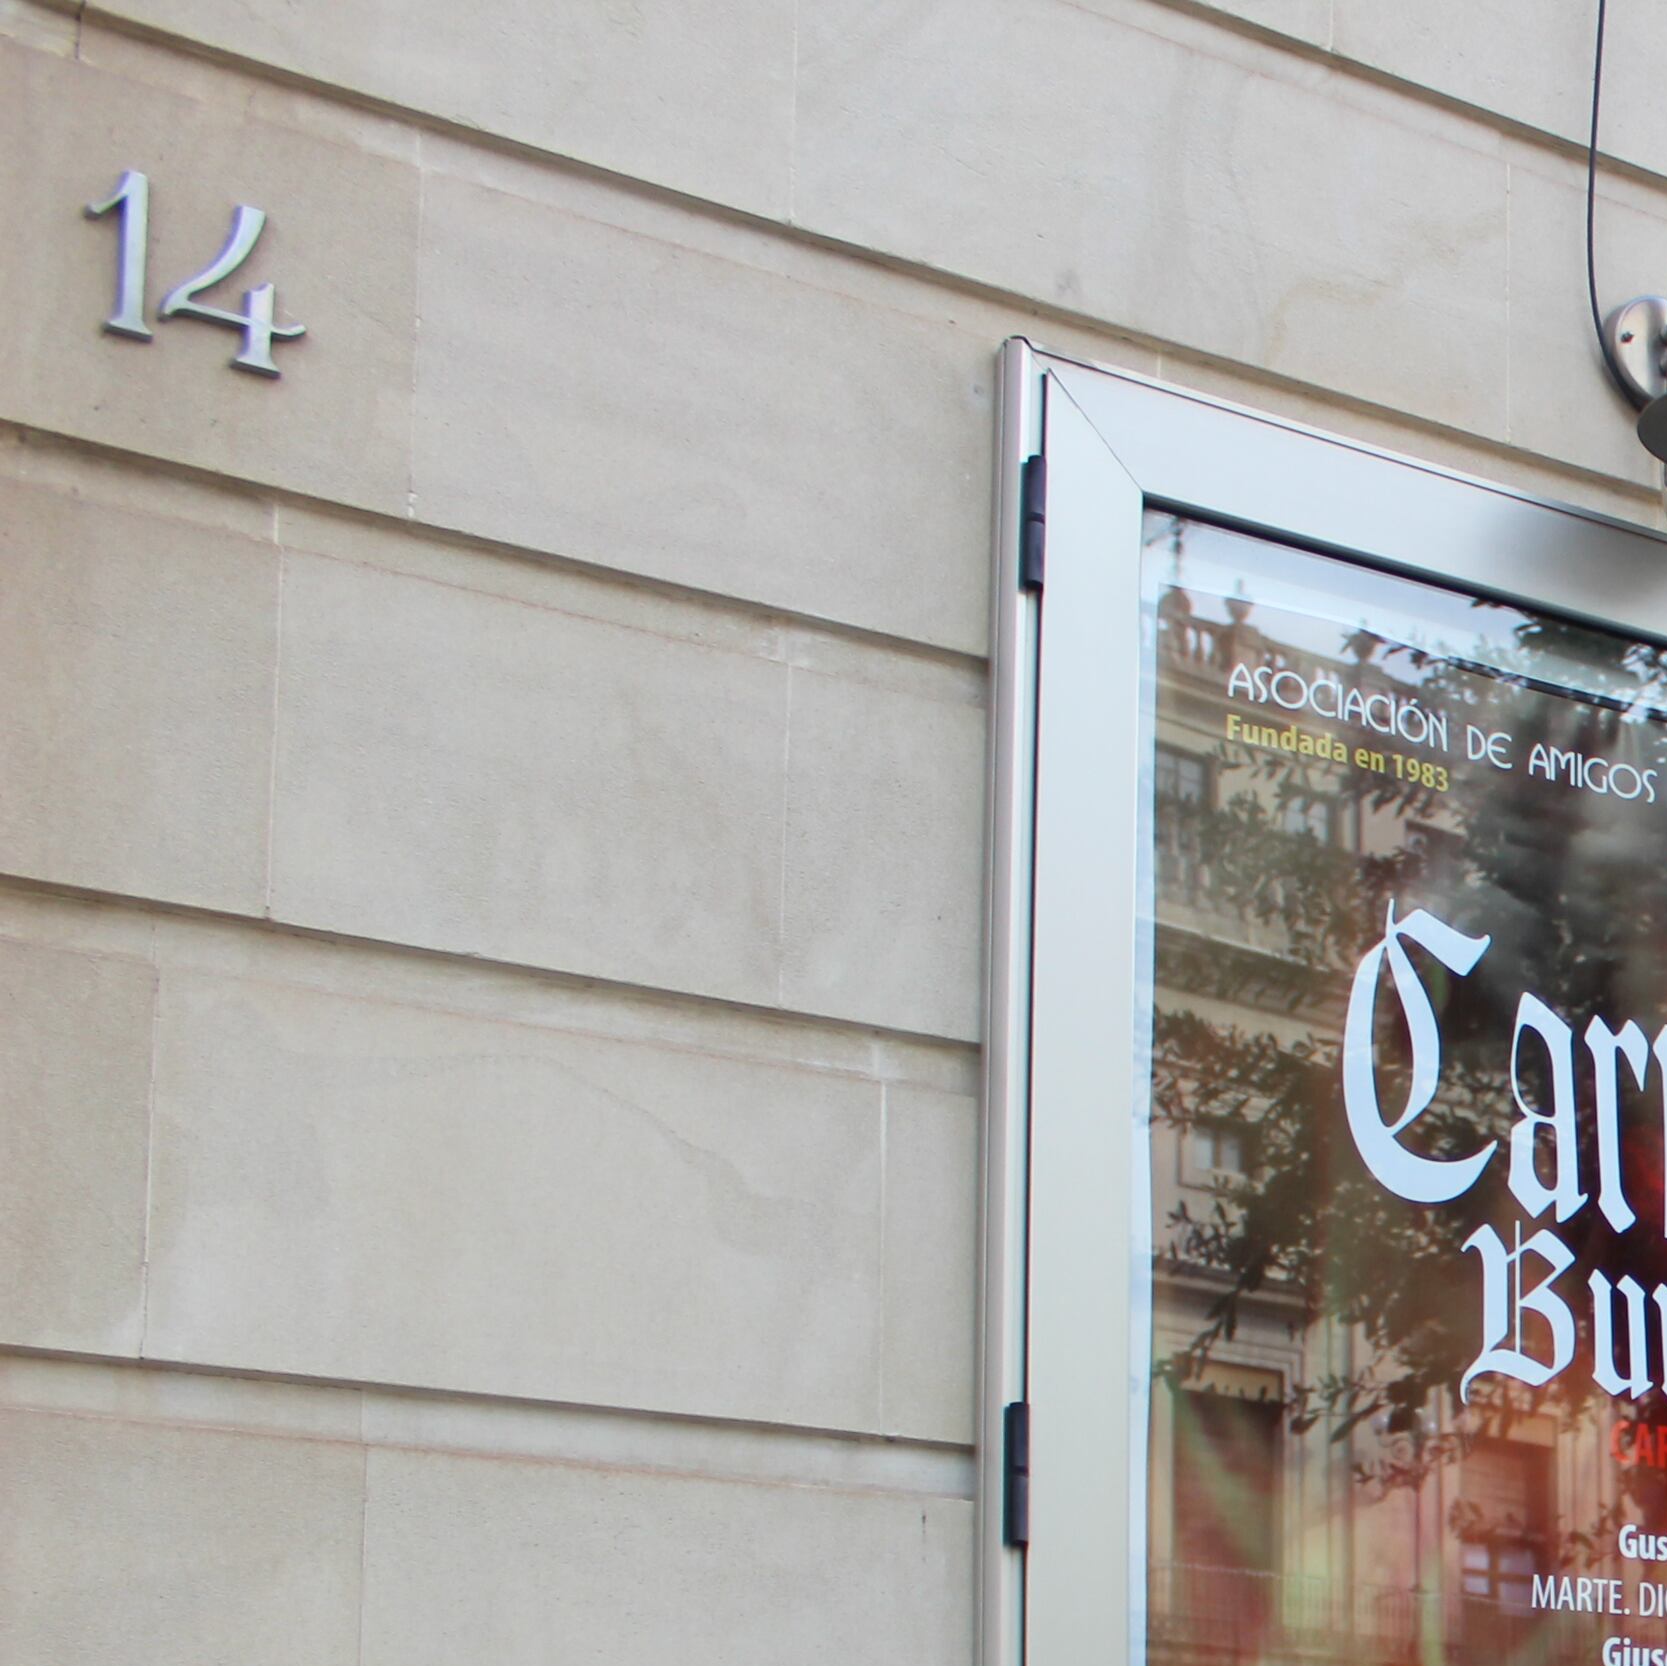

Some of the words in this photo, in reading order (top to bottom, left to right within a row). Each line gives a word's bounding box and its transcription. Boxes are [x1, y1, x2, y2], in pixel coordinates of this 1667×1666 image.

[82, 169, 307, 379] 14
[1226, 714, 1347, 763] Fundada
[1354, 749, 1385, 774] en
[1392, 753, 1449, 792] 1983
[1228, 662, 1448, 751] ASOCIACIÓN
[1466, 726, 1513, 769] DE
[1528, 743, 1657, 803] AMIGOS
[1530, 1574, 1630, 1617] MARTE.
